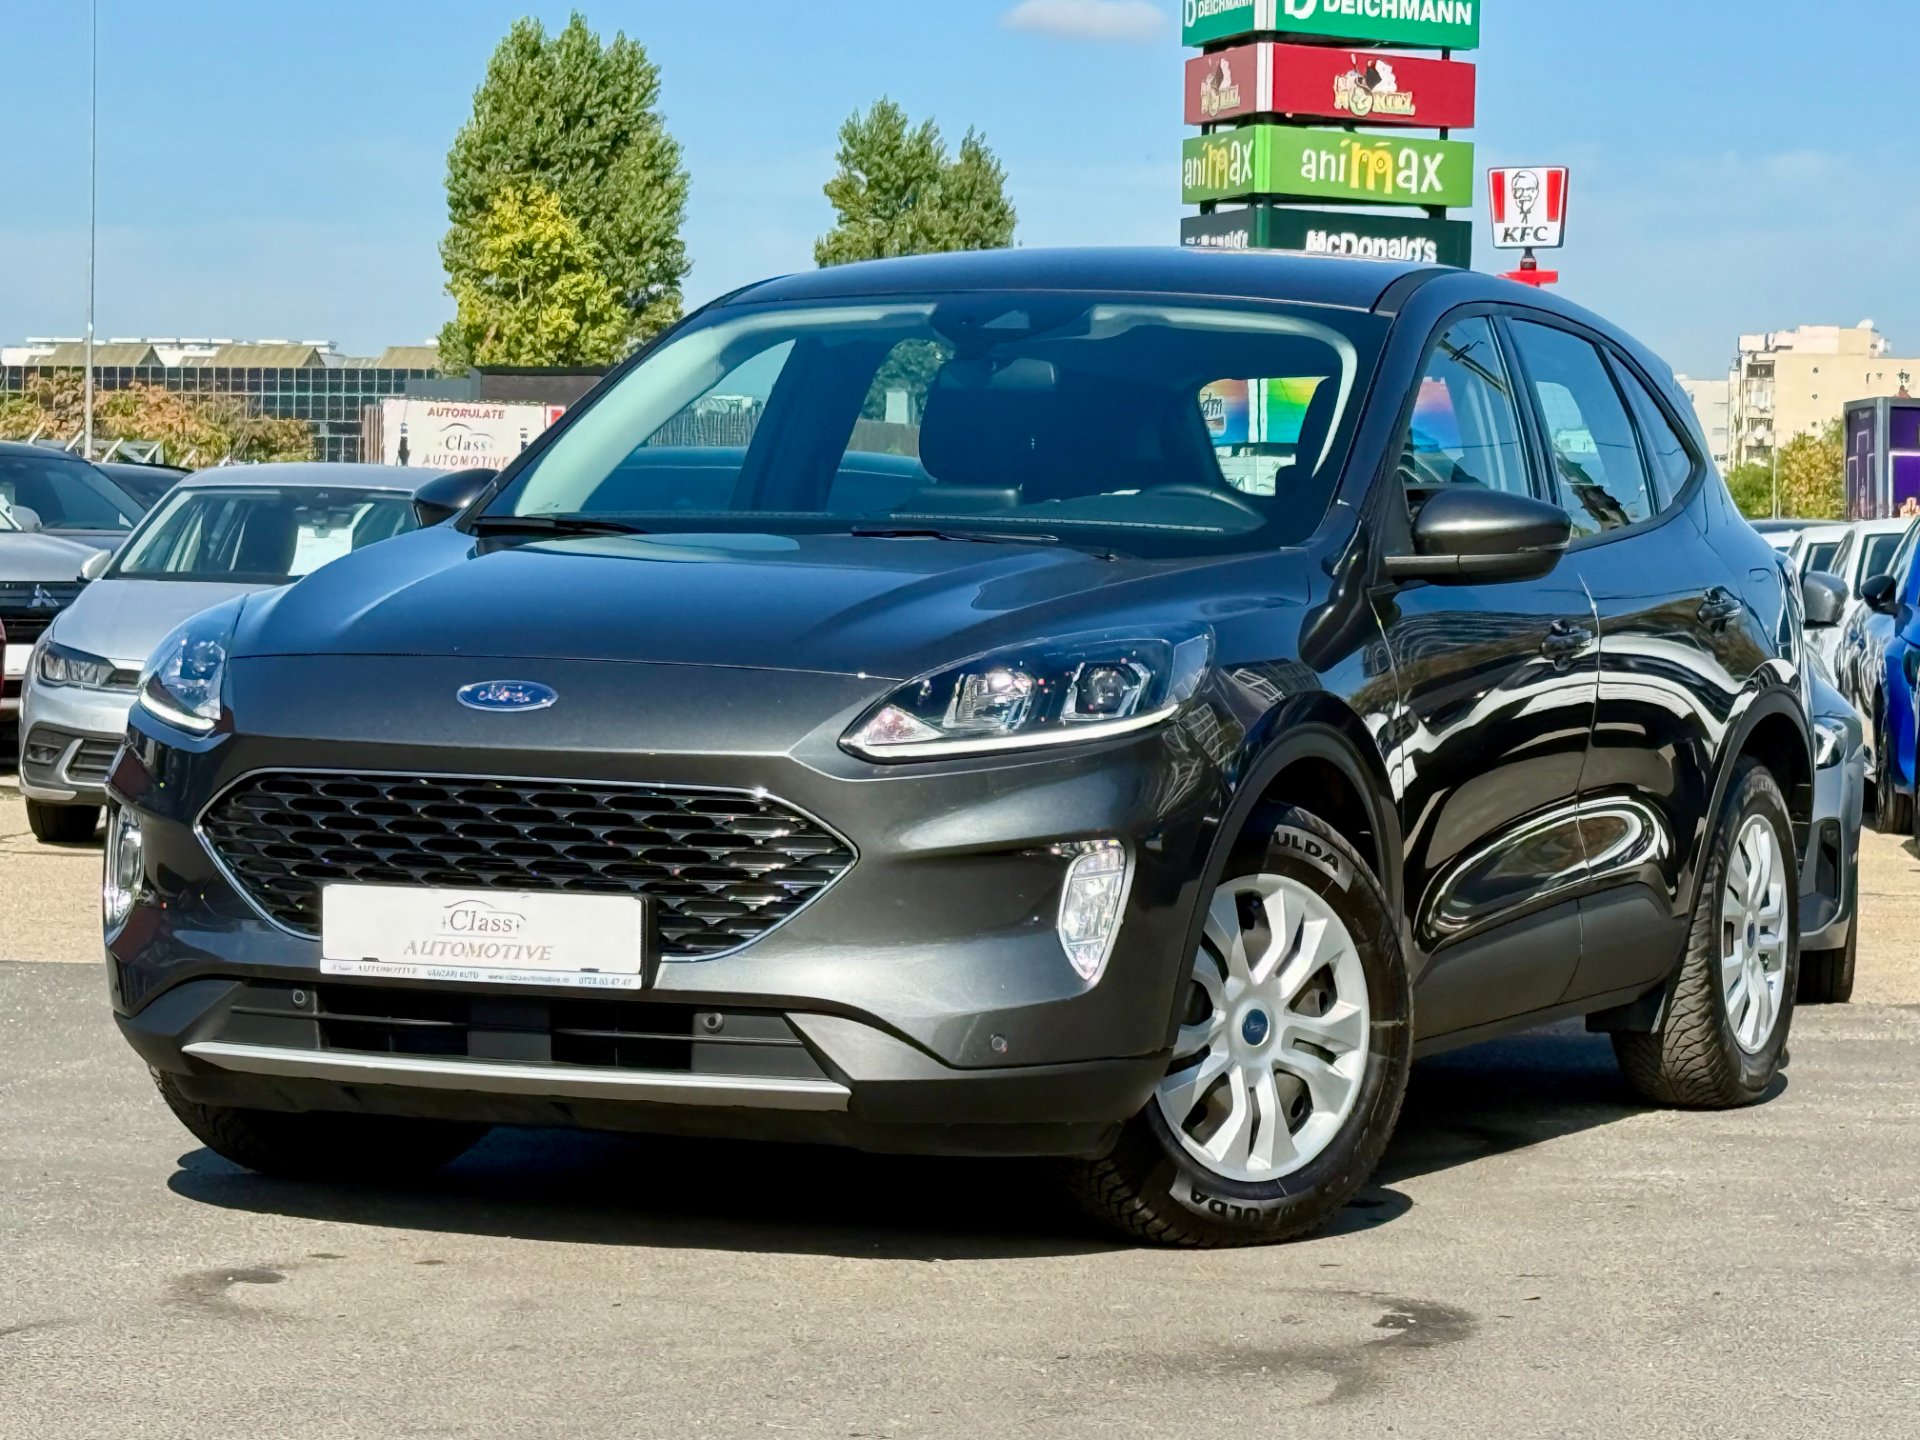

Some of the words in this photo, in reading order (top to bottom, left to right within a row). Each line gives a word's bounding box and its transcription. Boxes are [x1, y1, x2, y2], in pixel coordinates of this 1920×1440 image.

[1301, 138, 1444, 195] animax
[1305, 229, 1437, 263] McDonald's
[1502, 226, 1548, 243] KFC
[445, 434, 487, 452] Class
[1273, 831, 1339, 873] ULDA
[450, 909, 512, 933] Class
[404, 939, 553, 961] AUTOMOTIVE
